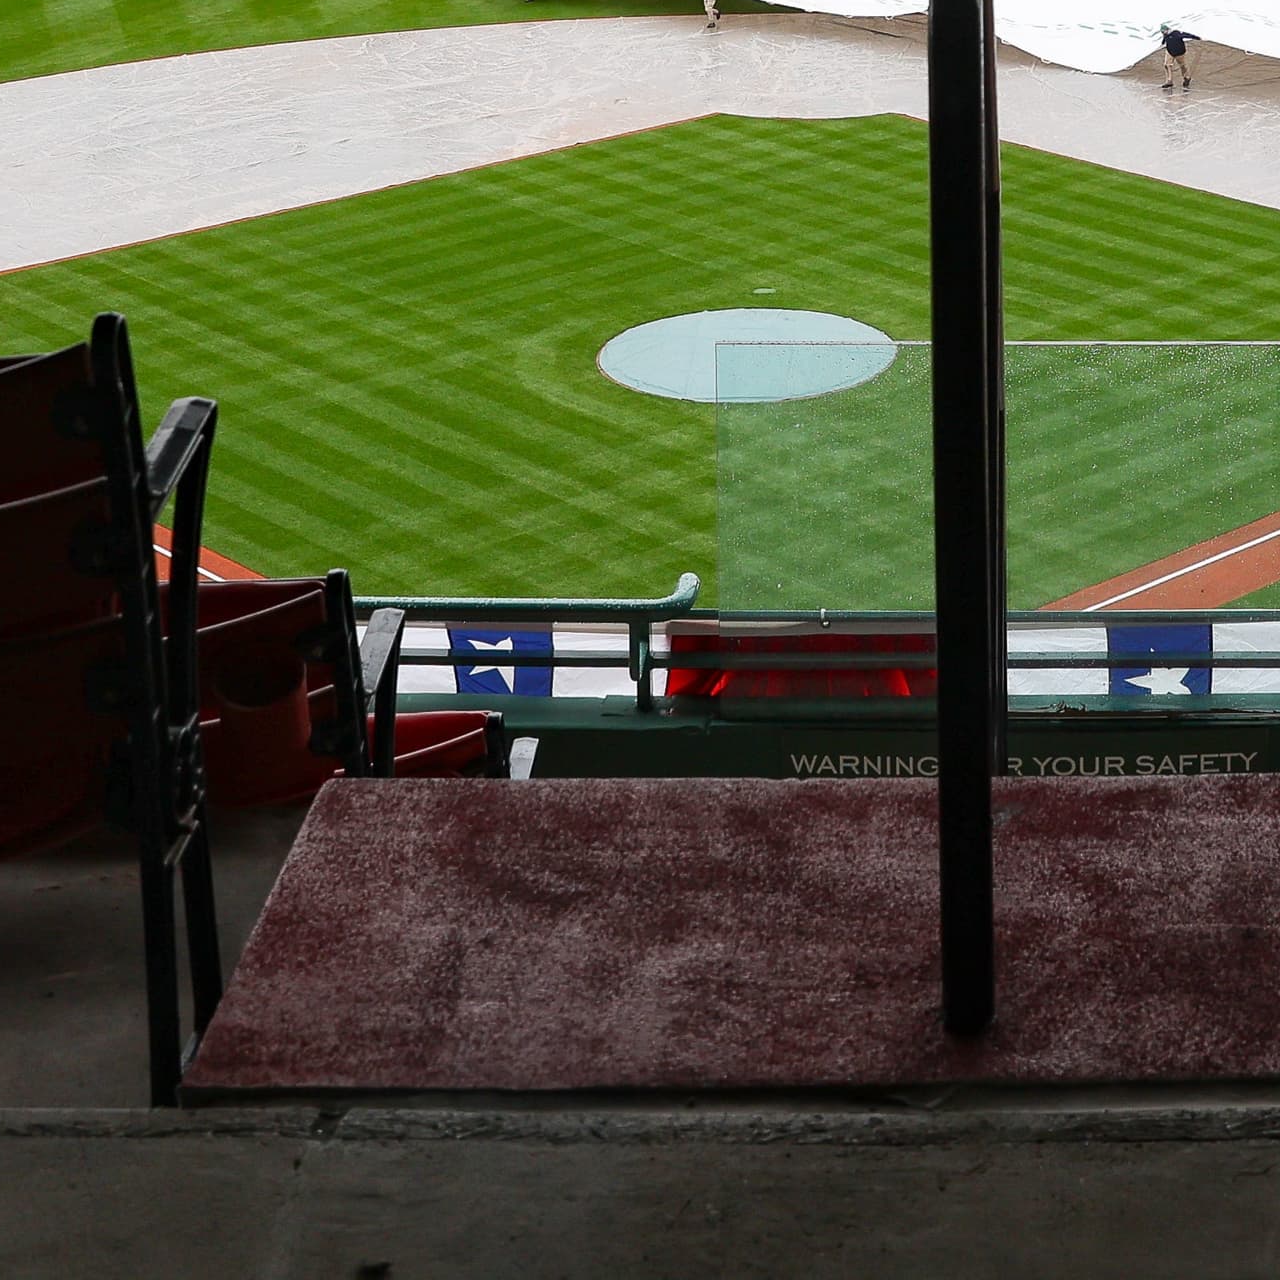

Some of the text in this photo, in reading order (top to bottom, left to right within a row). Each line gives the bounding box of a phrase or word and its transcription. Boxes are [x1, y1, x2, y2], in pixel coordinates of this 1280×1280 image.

[791, 754, 940, 776] WARNING
[1033, 755, 1124, 776] YOUR
[1135, 751, 1259, 775] SAFETY
